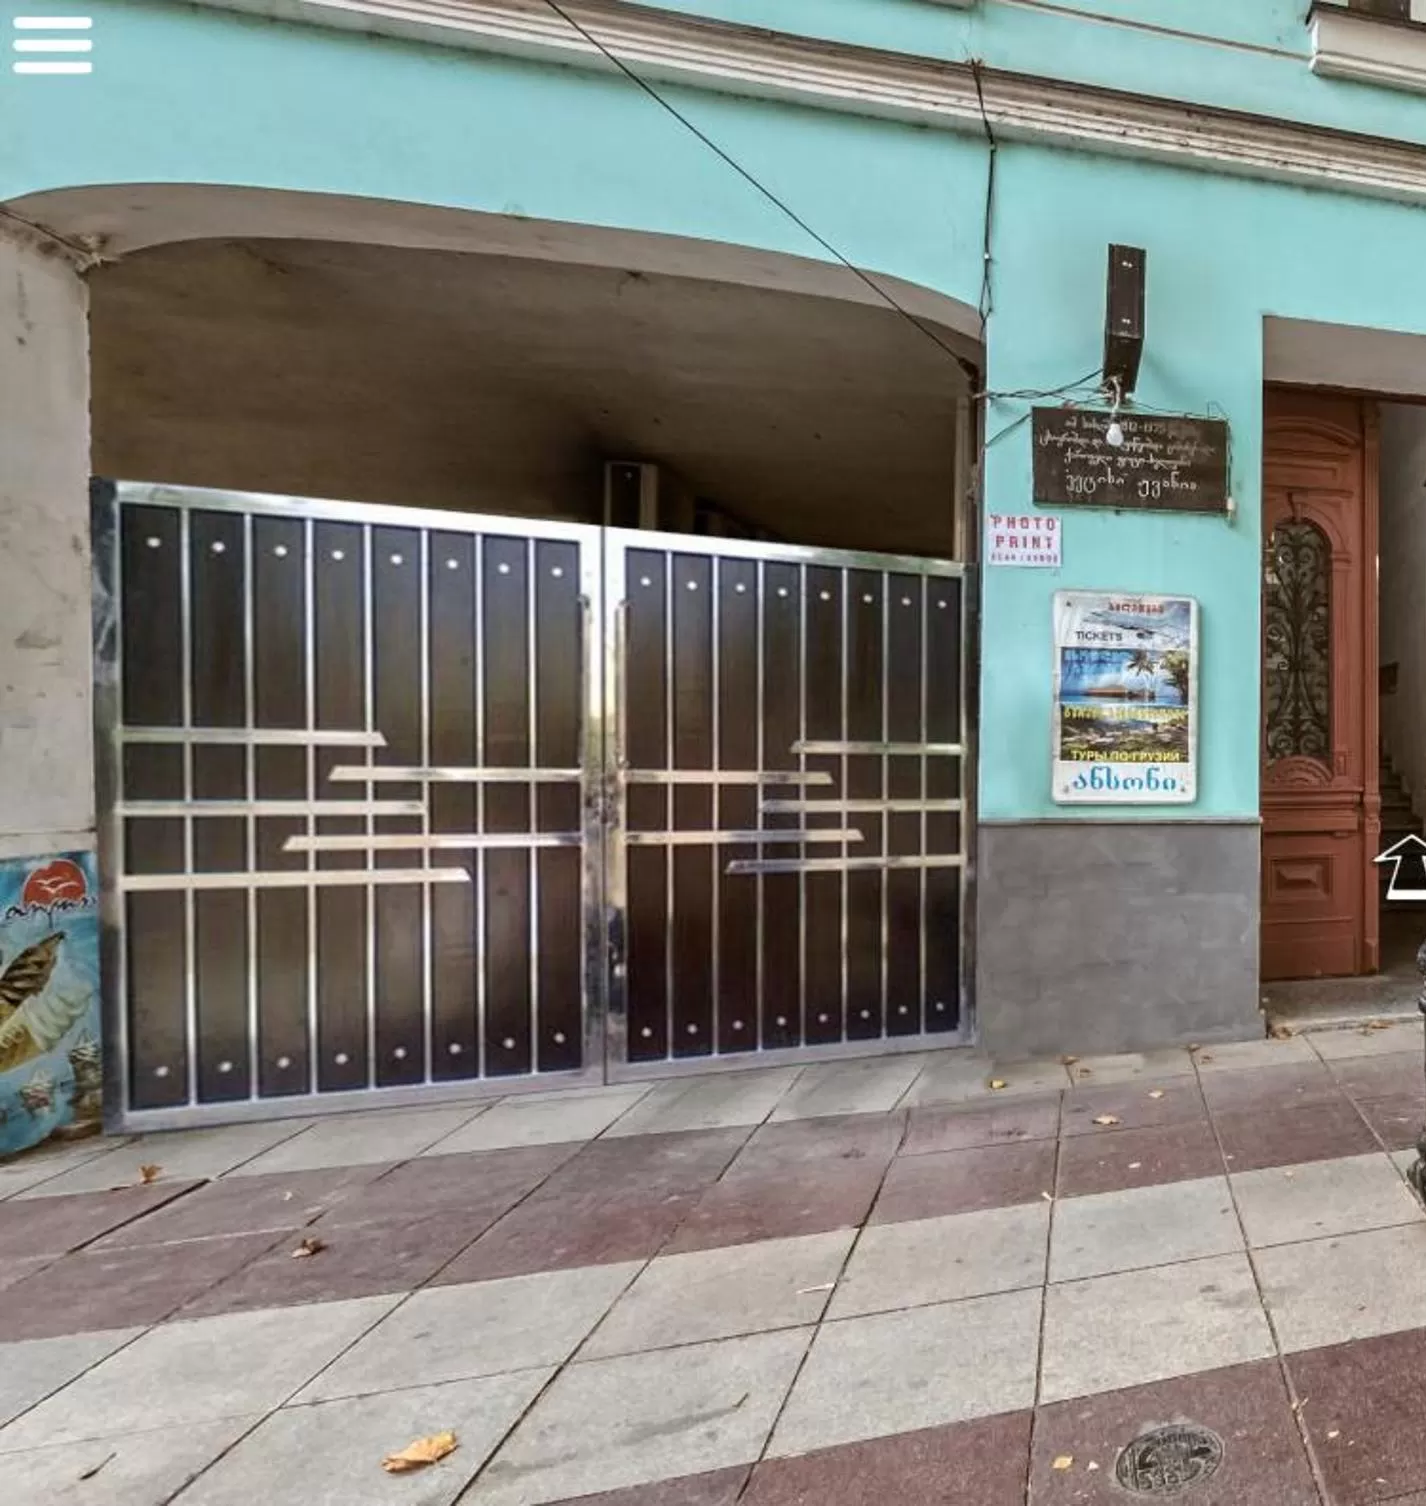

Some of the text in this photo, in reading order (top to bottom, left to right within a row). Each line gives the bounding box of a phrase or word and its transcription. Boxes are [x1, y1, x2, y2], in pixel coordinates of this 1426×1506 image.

[991, 515, 1057, 531] PHOTO
[996, 535, 1053, 549] PRINT
[1076, 630, 1123, 642] TICKETS
[1071, 750, 1180, 761] ТУРЫ ПО ГРУЗИИ
[1073, 766, 1176, 792] ანსონი
